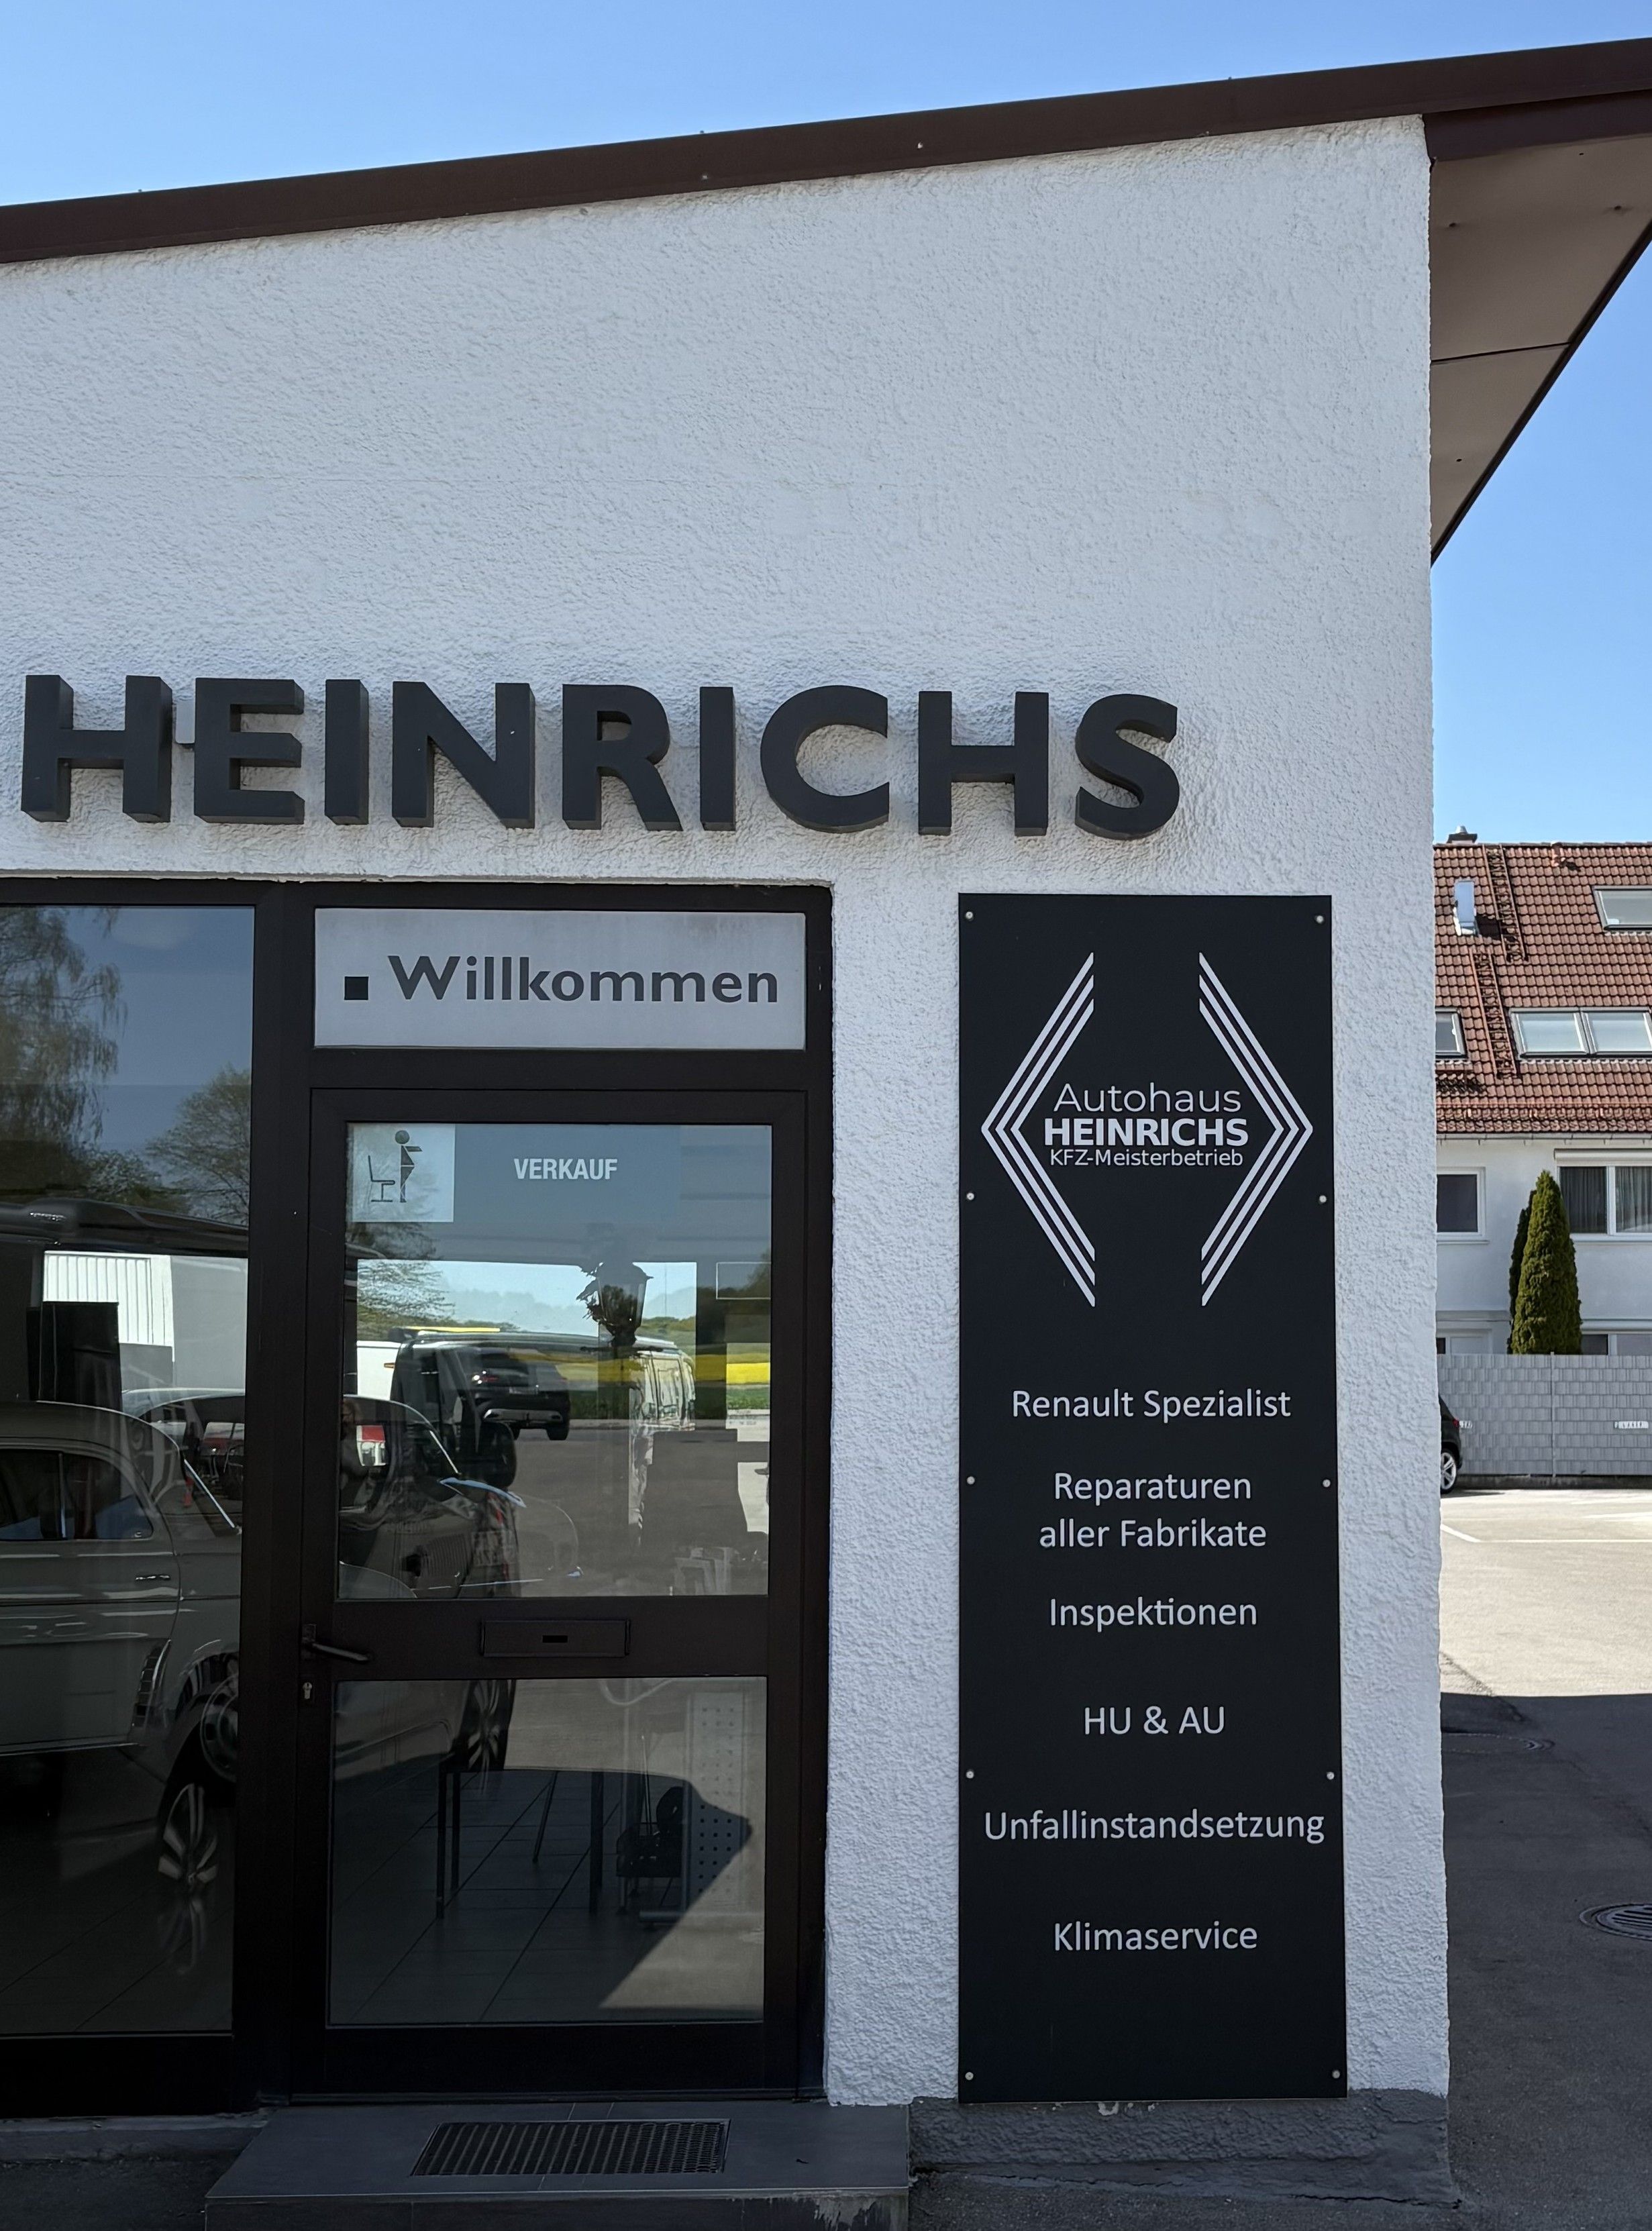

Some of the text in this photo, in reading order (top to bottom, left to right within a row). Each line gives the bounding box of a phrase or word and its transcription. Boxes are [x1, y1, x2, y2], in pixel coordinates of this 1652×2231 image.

[21, 674, 1180, 840] HEINRICHS
[388, 955, 778, 1003] Willkommen
[1054, 1082, 1242, 1113] Autohaus
[1044, 1118, 1249, 1147] HEINRICHS
[513, 1157, 618, 1180] VERKAUF
[1049, 1148, 1244, 1167] KFZ-Meisterbetrieb
[1013, 1388, 1292, 1424] Renault Spezialist
[1054, 1472, 1252, 1506] Reparaturen
[1039, 1518, 1267, 1548] aller Fabrikate
[1050, 1596, 1257, 1632] Inspektionen
[1084, 1706, 1225, 1734] HU & AU
[984, 1808, 1325, 1844] Unfallinstandsetzung
[1054, 1920, 1258, 1951] Klimaservice
